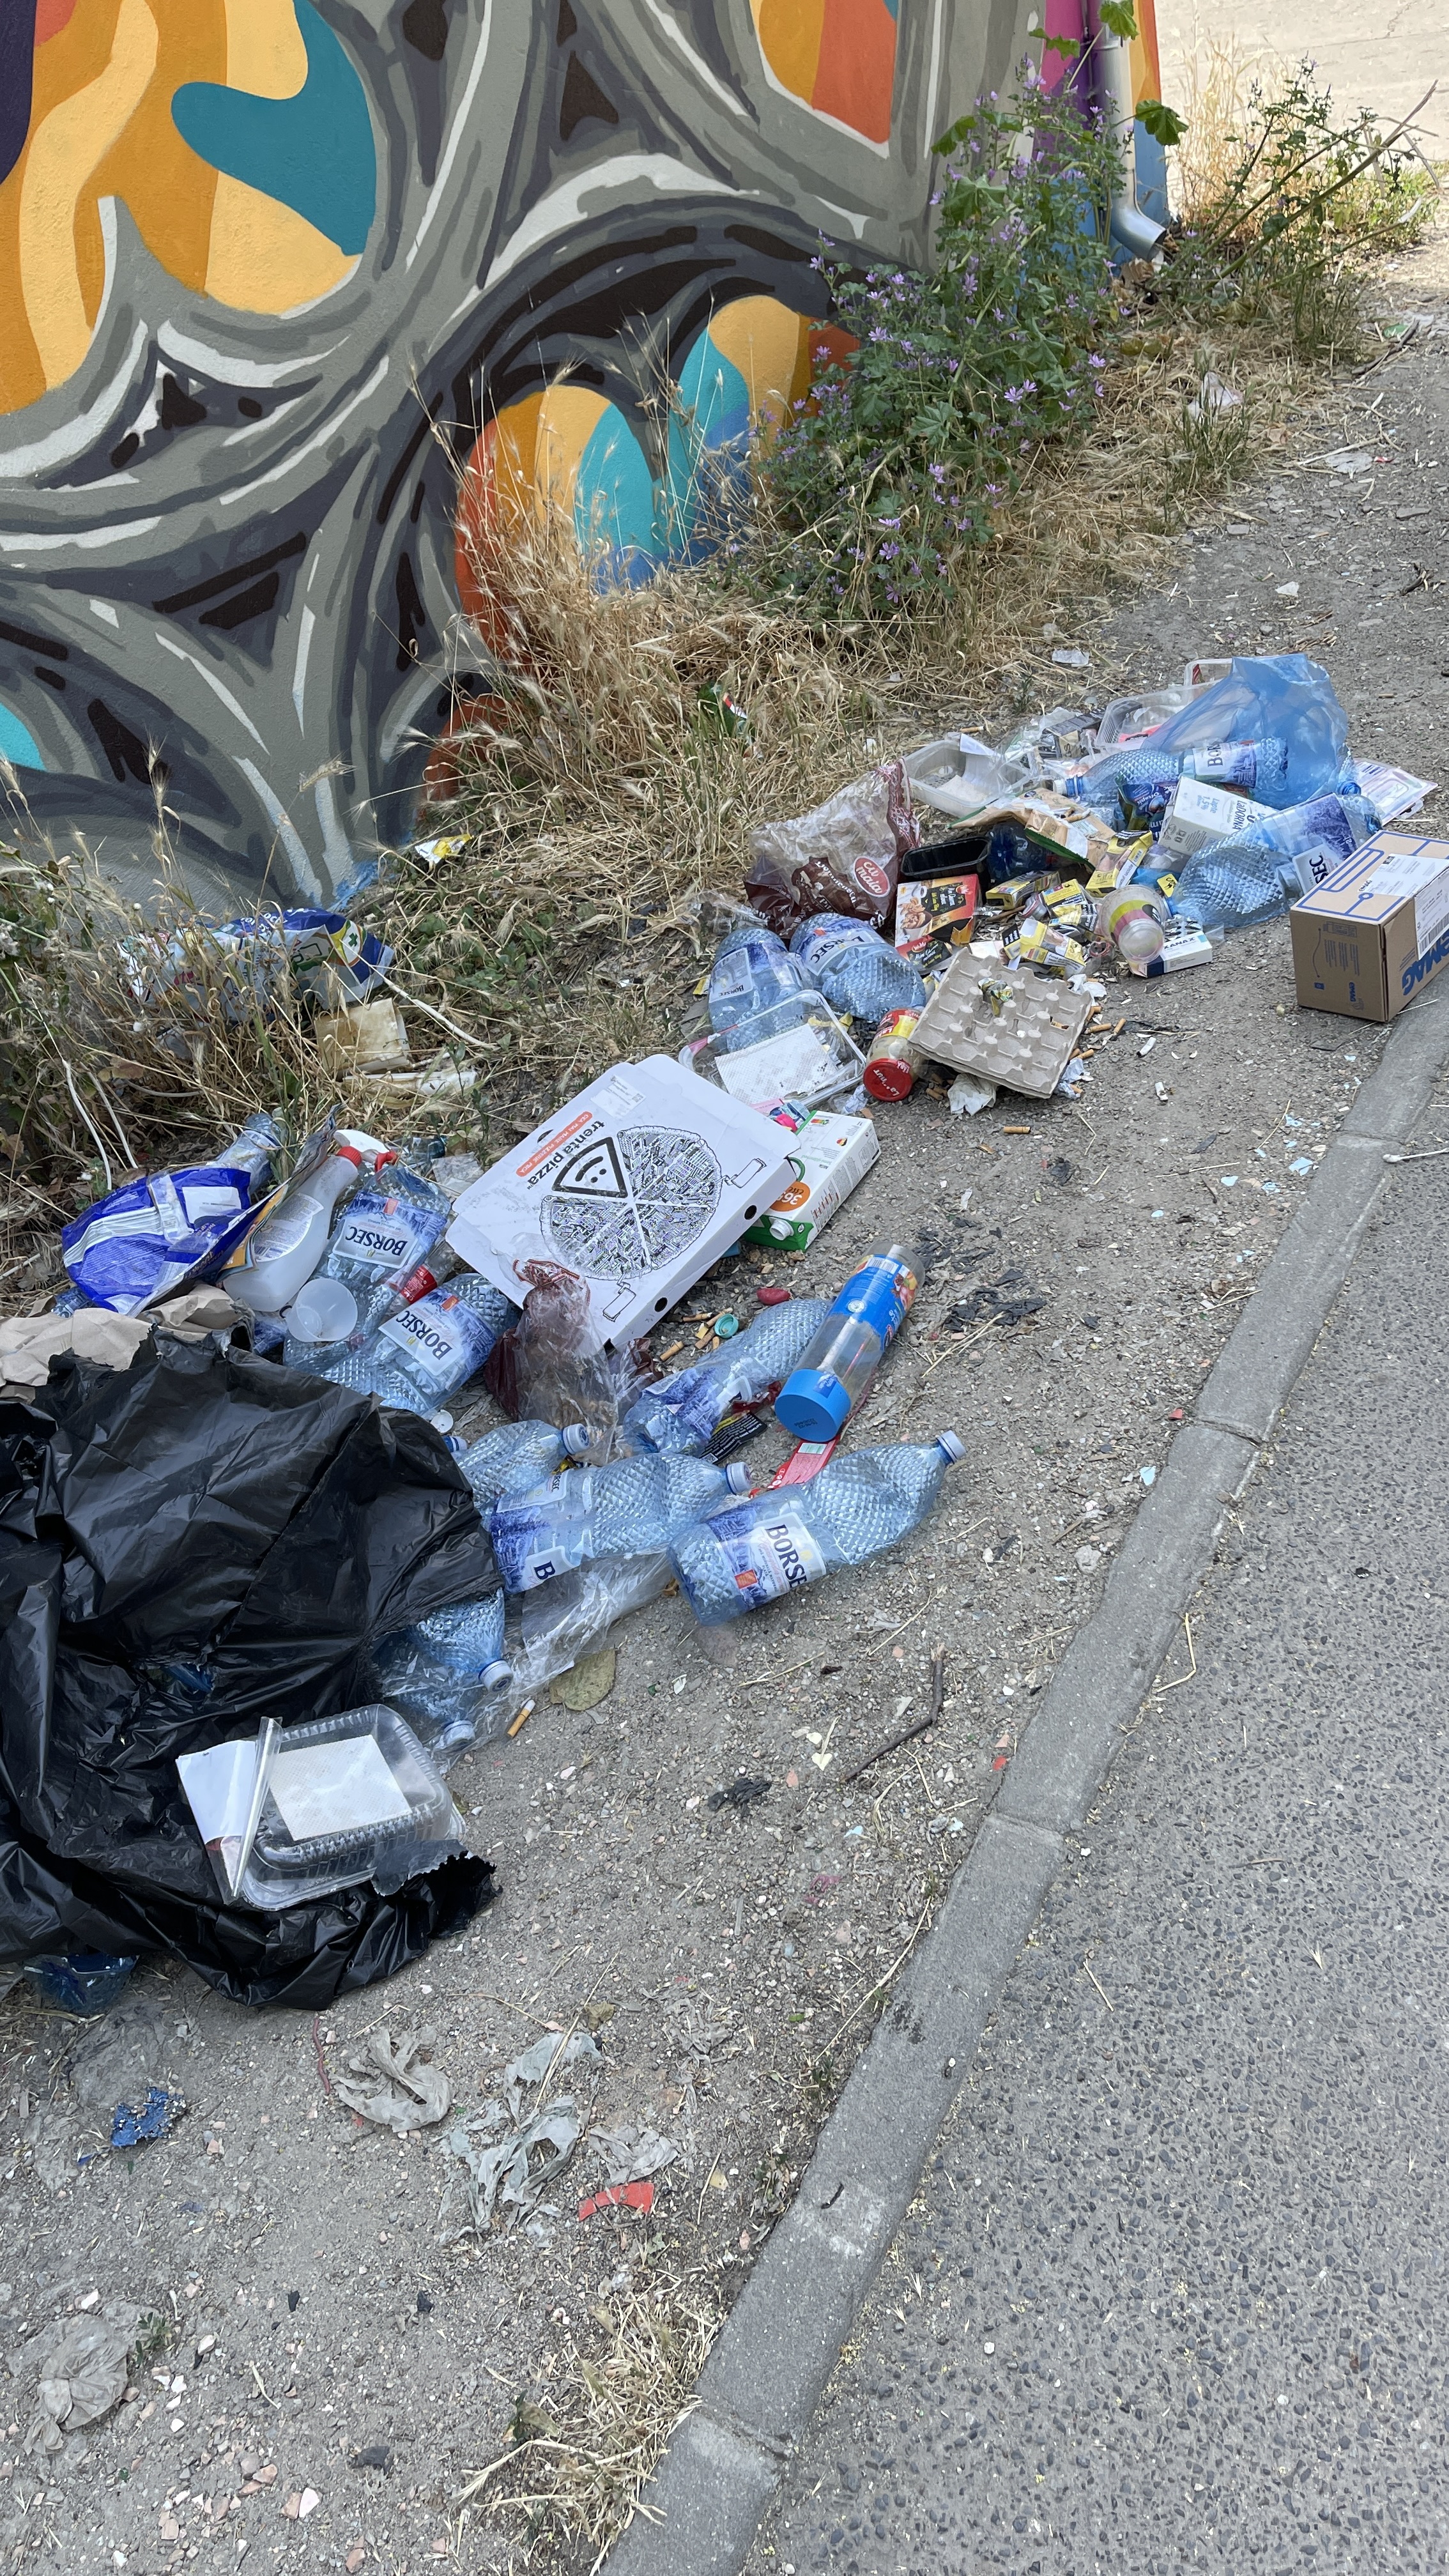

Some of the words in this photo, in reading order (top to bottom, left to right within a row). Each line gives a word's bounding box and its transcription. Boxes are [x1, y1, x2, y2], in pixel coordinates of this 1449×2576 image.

[855, 866, 882, 894] maia
[863, 861, 878, 877] cu
[568, 1123, 578, 1132] MAI
[578, 1114, 588, 1123] CEA
[555, 1131, 569, 1144] MARE
[563, 1121, 605, 1156] trenta
[346, 1227, 408, 1256] BORSEC
[395, 1309, 452, 1361] BORSEC
[766, 1524, 807, 1589] BORSE
